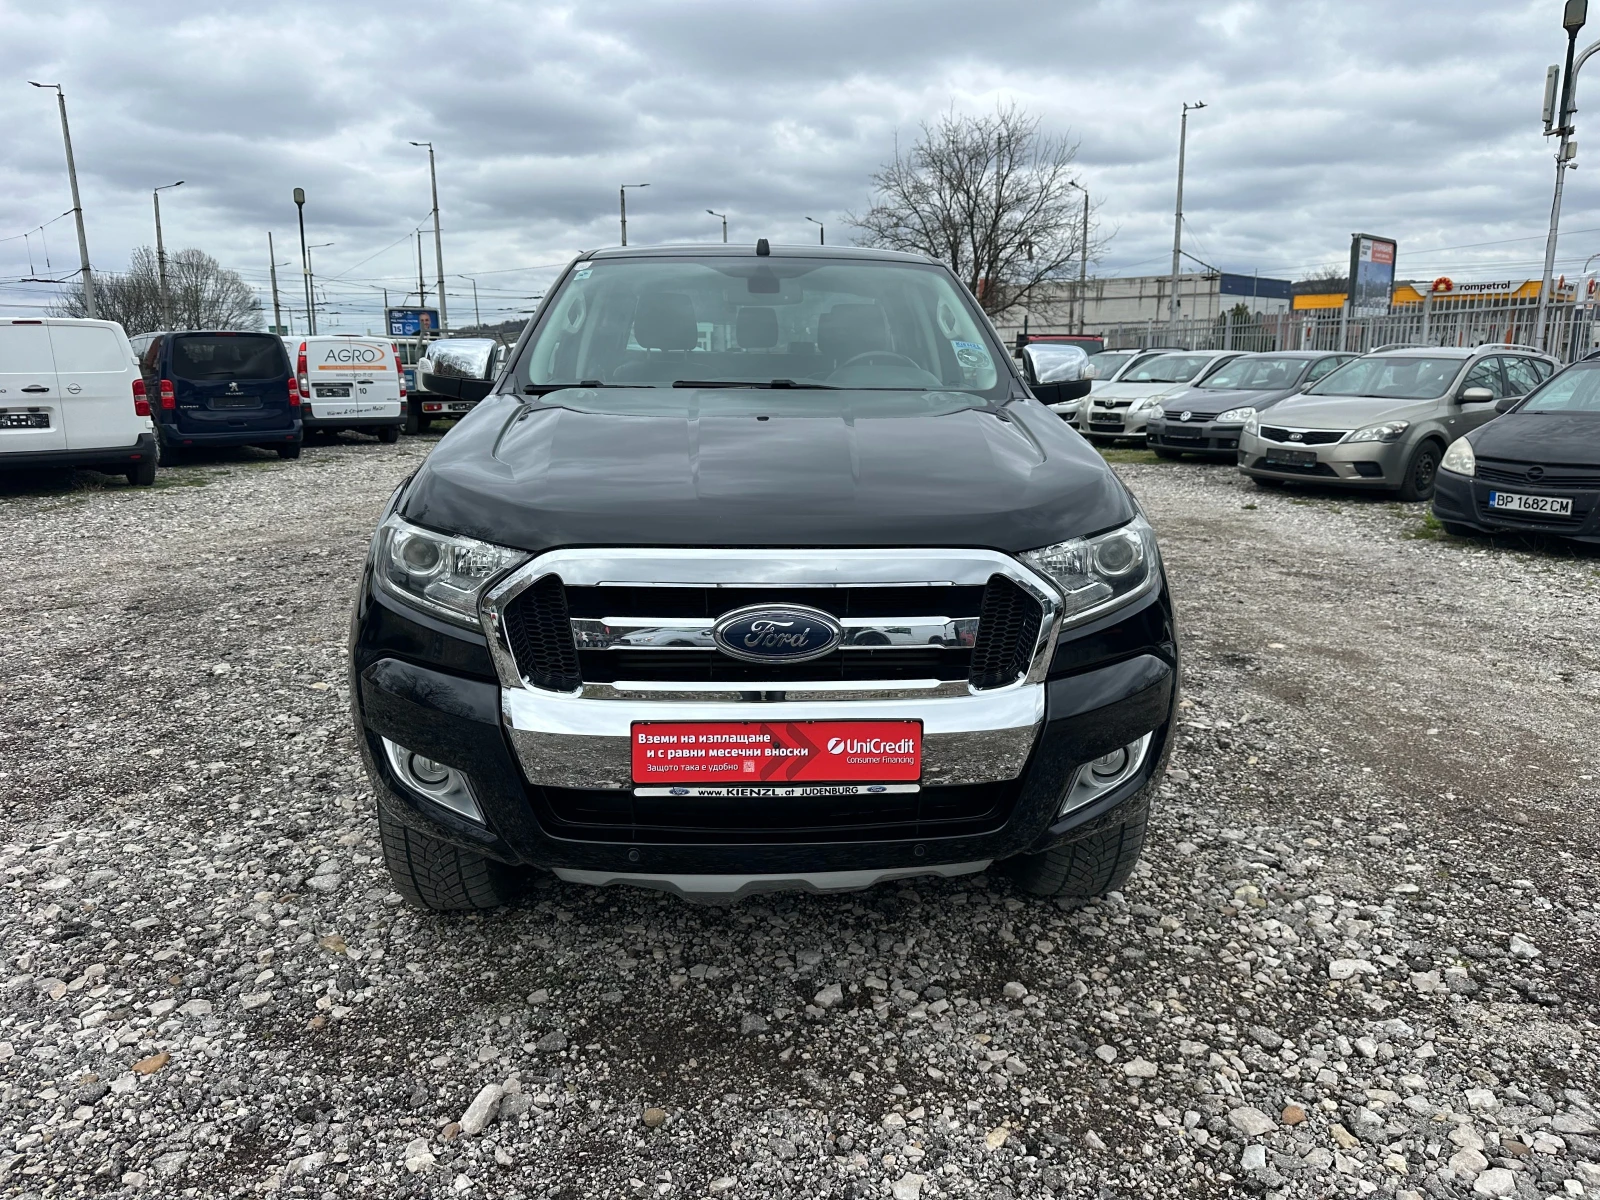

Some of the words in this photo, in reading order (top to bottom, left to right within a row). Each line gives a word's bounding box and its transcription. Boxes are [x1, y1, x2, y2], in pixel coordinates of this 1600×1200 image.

[1459, 280, 1510, 292] rompetrol
[324, 349, 375, 362] AGRO
[1517, 496, 1549, 511] 1682
[744, 620, 811, 648] Ford
[638, 733, 677, 744] Вземи
[680, 735, 696, 743] на
[698, 734, 771, 744] изплащане
[846, 738, 915, 754] UniCredit
[646, 750, 655, 758] и
[657, 750, 665, 758] с
[667, 749, 706, 760] равни
[708, 748, 761, 757] месечни
[764, 747, 809, 757] вноски
[846, 756, 880, 764] Consumer
[882, 755, 915, 766] Financing
[647, 763, 679, 772] Защото
[708, 762, 739, 772] удобно
[697, 788, 795, 797] www.KIENZL.at
[799, 785, 859, 796] JUDENBURG
